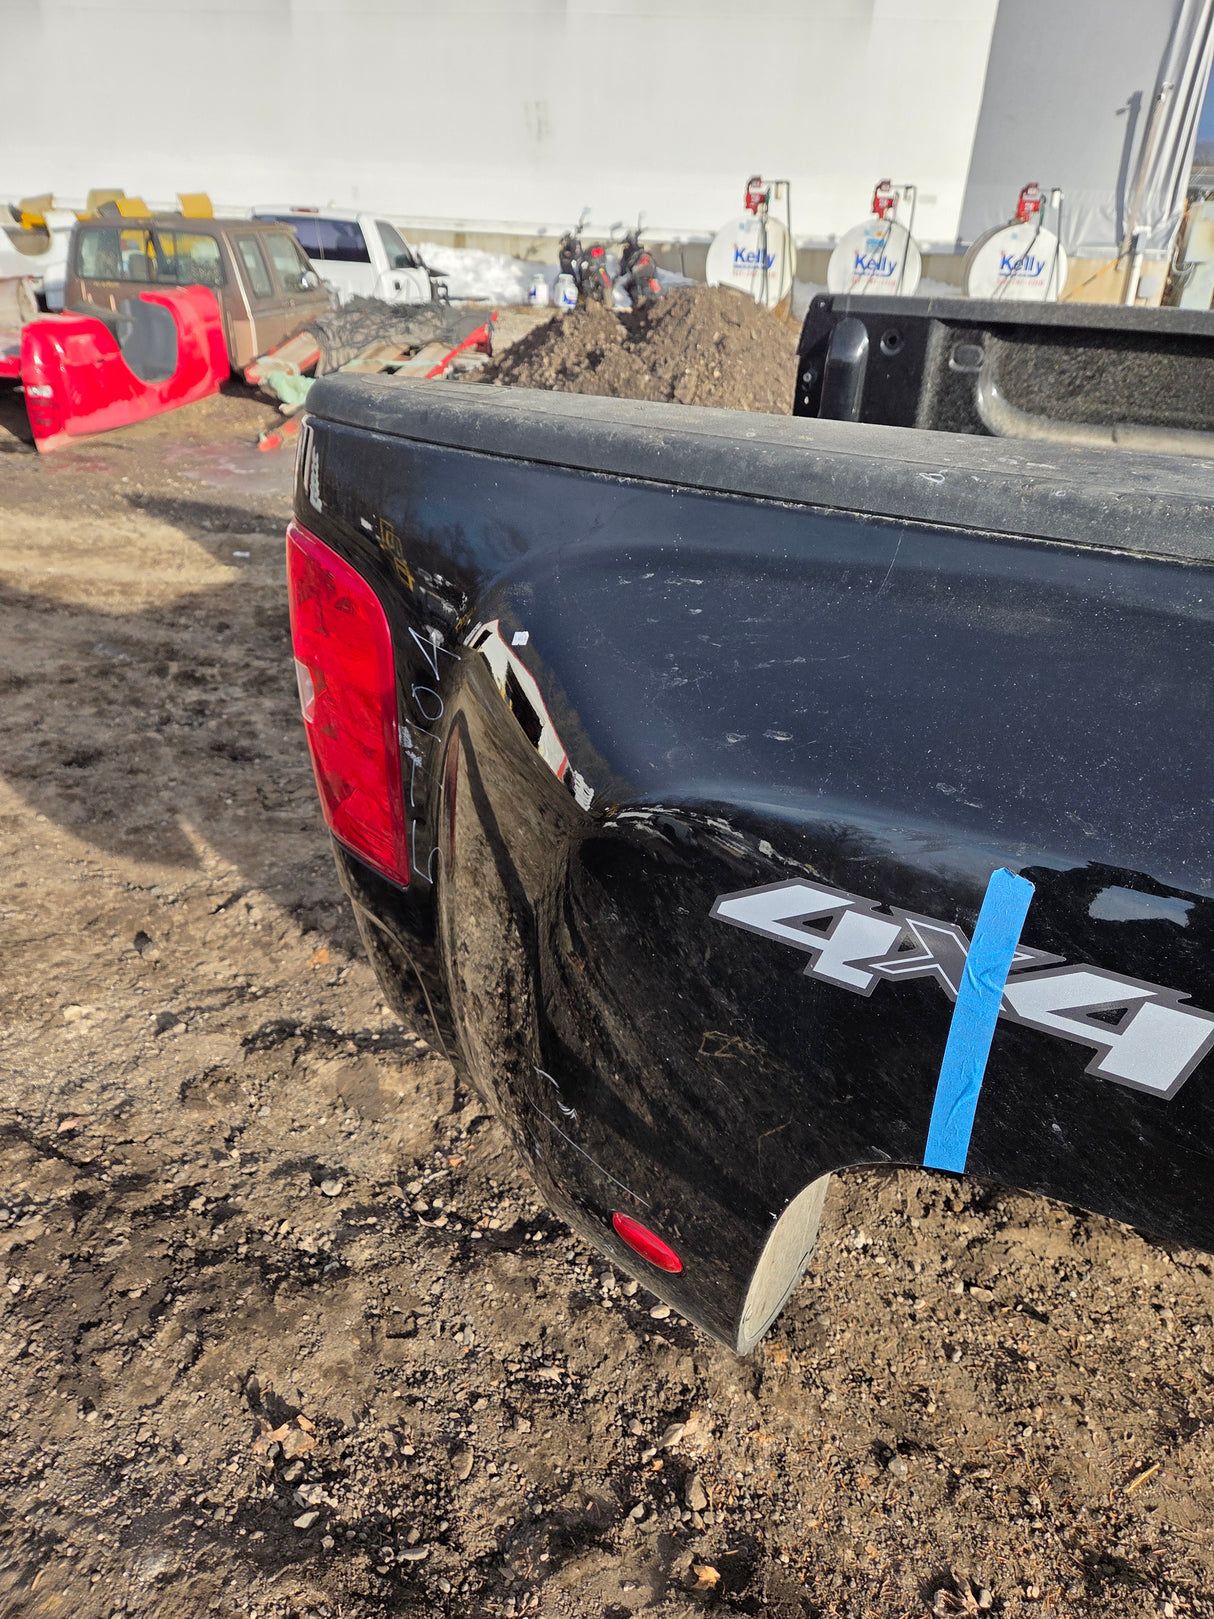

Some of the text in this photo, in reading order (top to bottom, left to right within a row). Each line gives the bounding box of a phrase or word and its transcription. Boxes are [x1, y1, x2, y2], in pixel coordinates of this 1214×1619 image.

[734, 248, 776, 270] Kelly
[855, 254, 898, 277] Kelly
[1000, 255, 1046, 277] Kelly
